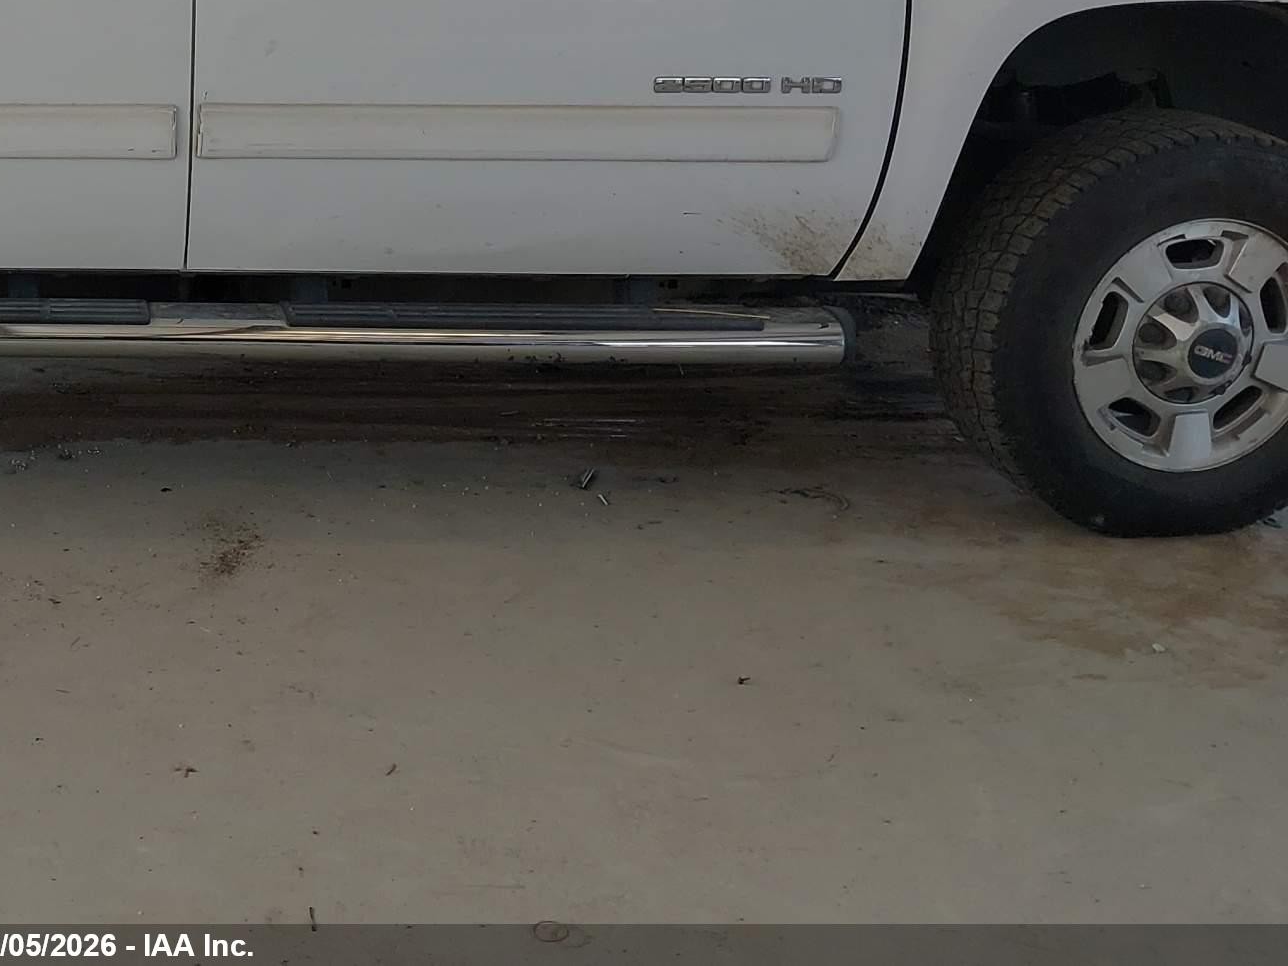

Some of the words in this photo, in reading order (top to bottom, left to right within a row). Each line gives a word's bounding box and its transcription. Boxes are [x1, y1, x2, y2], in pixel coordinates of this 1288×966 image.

[653, 77, 772, 94] 2500
[780, 77, 843, 94] HD
[1193, 344, 1234, 364] GMC
